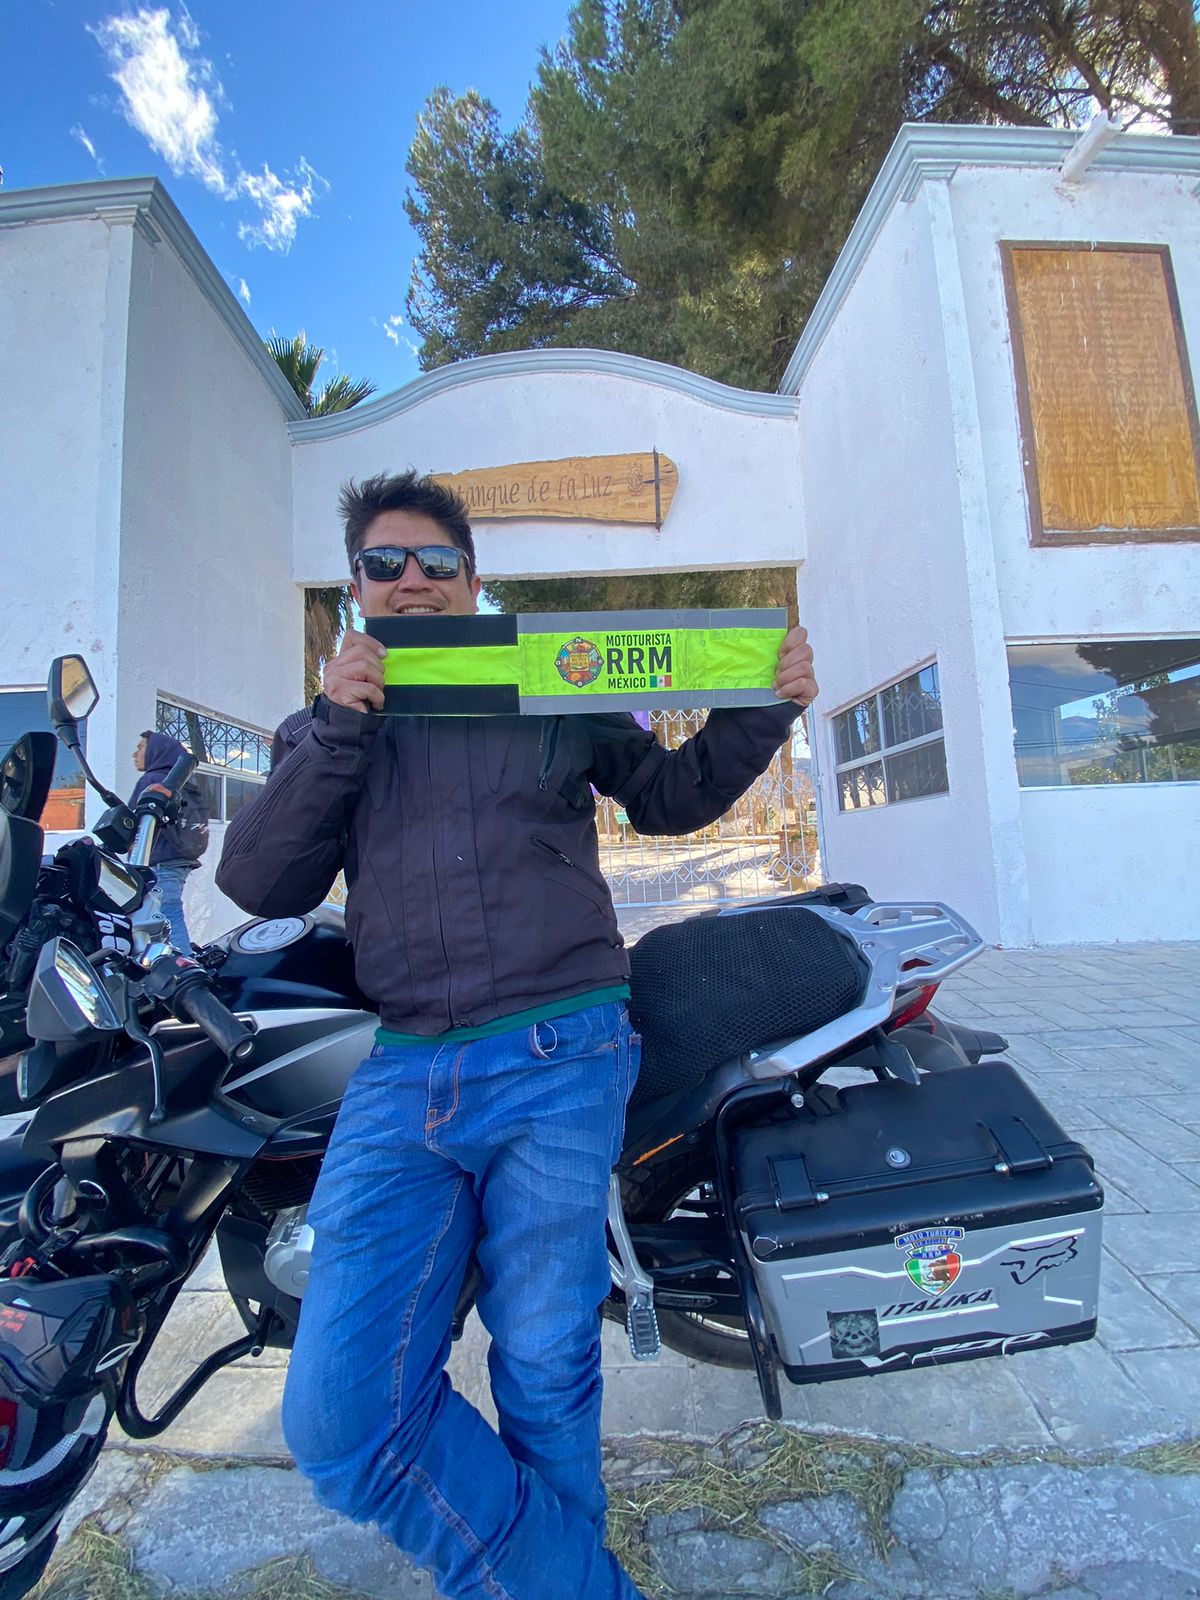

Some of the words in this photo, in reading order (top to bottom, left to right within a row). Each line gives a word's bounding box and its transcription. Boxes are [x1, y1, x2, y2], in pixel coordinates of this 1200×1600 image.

[456, 482, 520, 514] tanque
[527, 475, 550, 503] de
[606, 633, 672, 647] MOTOTURISTA
[606, 646, 672, 675] RRM
[608, 675, 646, 689] MÉXICO
[903, 1232, 924, 1243] MOTO
[926, 1229, 956, 1238] TURISTA
[881, 1288, 993, 1317] ITALIKA
